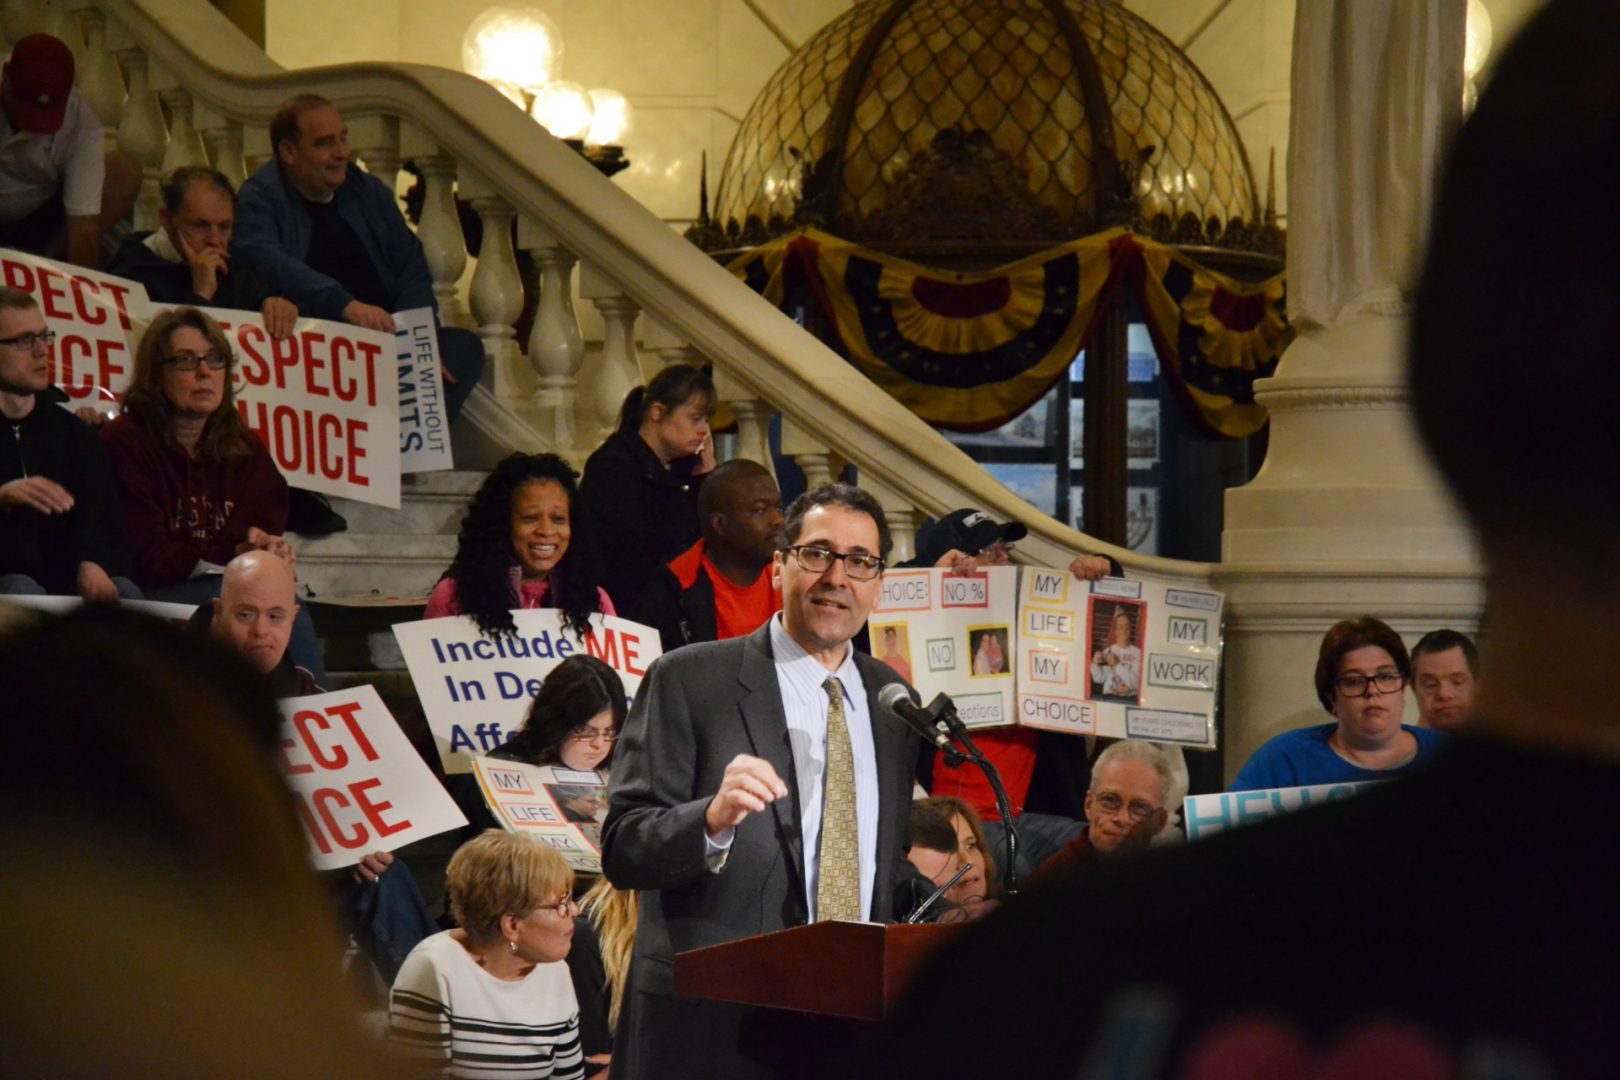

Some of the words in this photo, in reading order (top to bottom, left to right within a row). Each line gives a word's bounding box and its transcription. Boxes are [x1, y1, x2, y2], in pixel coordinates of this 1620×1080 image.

[413, 325, 434, 363] LIFE
[219, 321, 382, 407] SPECT
[419, 367, 445, 454] WITHOUT
[945, 583, 967, 601] NO
[971, 582, 984, 600] %
[1034, 574, 1063, 594] MY
[1031, 613, 1068, 634] LIFE
[1172, 621, 1200, 641] MY
[431, 630, 575, 664] Include
[583, 624, 646, 677] ME
[931, 644, 951, 664] NO
[1034, 656, 1060, 676] MY
[1153, 661, 1209, 683] WORK
[445, 675, 486, 703] In
[1023, 697, 1092, 725] CHOICE
[494, 772, 523, 789] MY
[510, 807, 557, 822] LIFE
